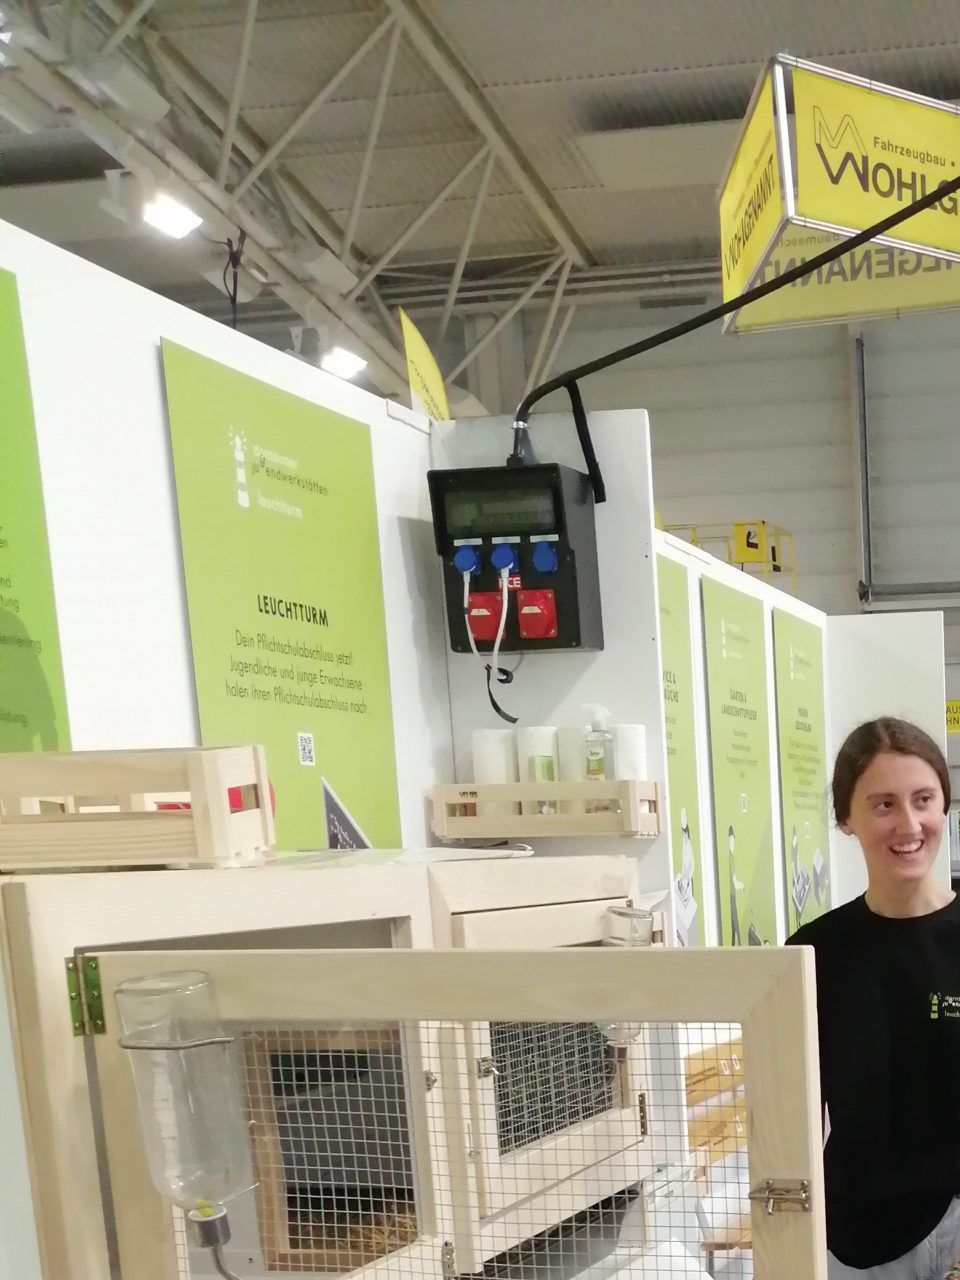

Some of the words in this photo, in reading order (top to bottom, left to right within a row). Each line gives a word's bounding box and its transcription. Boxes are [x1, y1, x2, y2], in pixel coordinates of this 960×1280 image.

[872, 135, 947, 168] Fahrzeugbau
[257, 594, 329, 627] LEUCHTTURM
[235, 629, 255, 648] Dein
[257, 633, 334, 663] Pflichtschulabschluss
[230, 655, 277, 677] Jugendliche
[279, 667, 295, 680] und
[297, 669, 318, 687] junge
[319, 669, 363, 690] Erwachsene
[225, 679, 249, 698] holen
[251, 684, 271, 700] ihren
